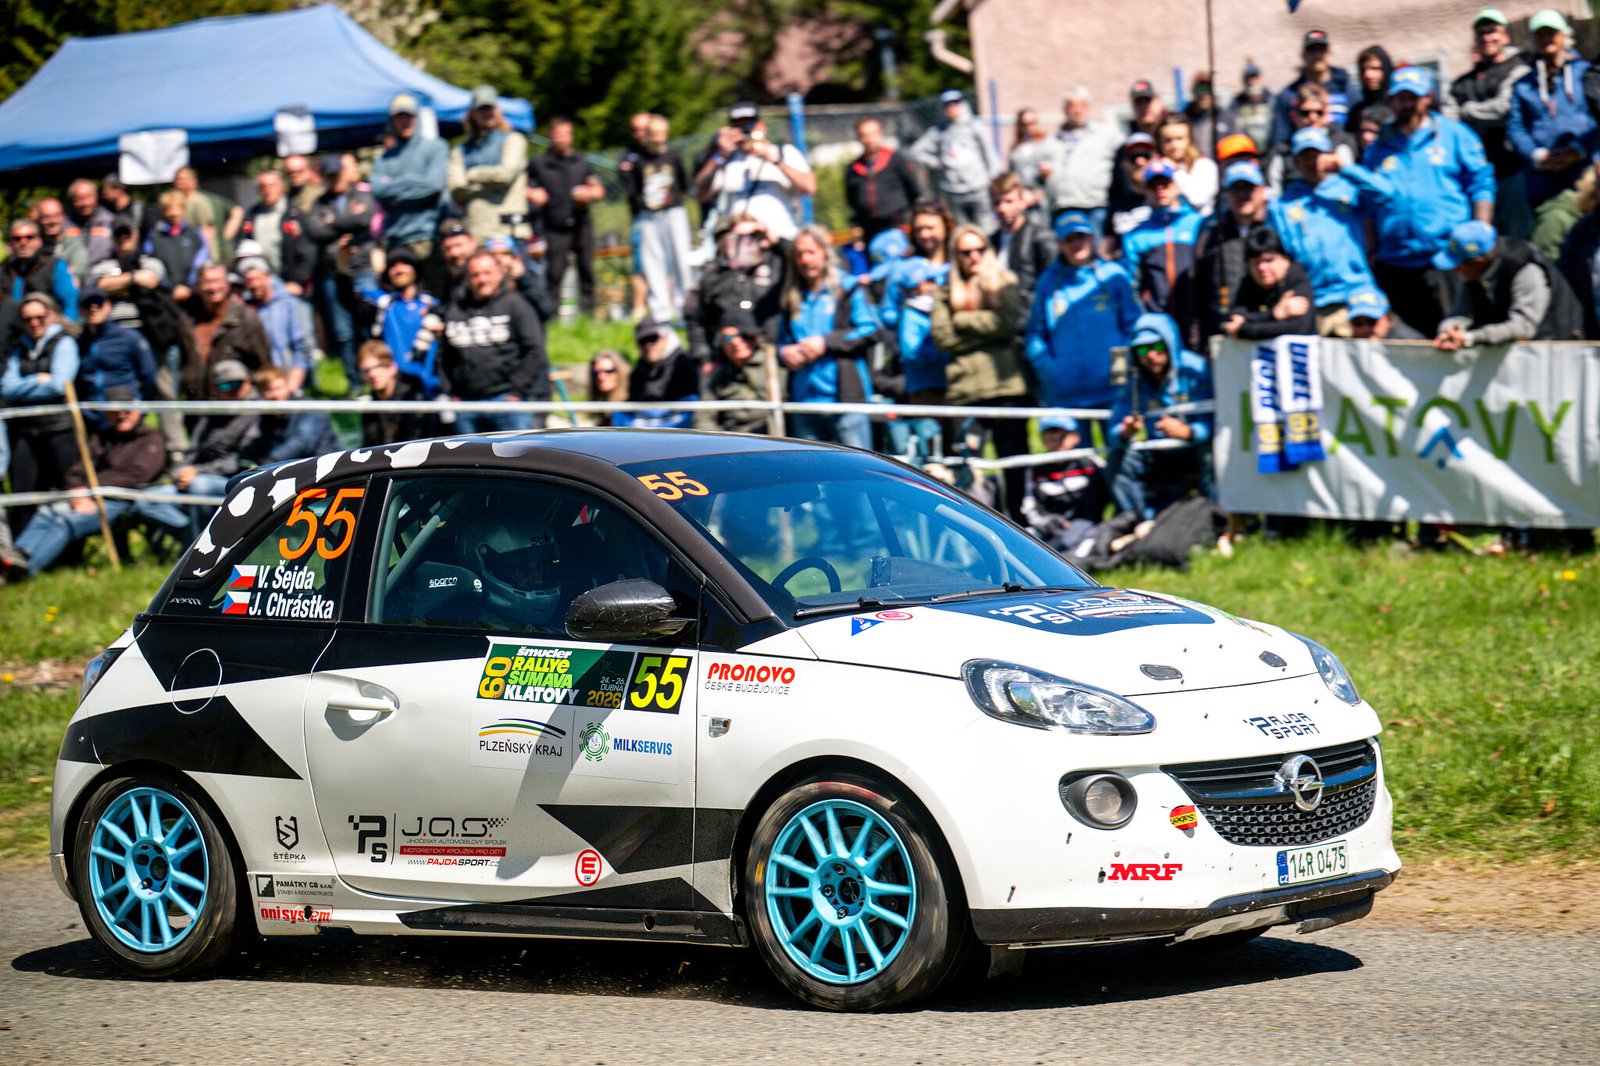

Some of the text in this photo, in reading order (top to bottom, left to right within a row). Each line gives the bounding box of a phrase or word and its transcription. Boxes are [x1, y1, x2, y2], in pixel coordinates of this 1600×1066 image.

[636, 471, 710, 501] 55
[279, 487, 366, 560] 55
[258, 560, 315, 594] V. Šejda
[248, 592, 335, 619] J. Chrástka
[707, 662, 796, 684] PRONOVO
[600, 684, 625, 692] DUBNA
[630, 656, 688, 709] 55
[704, 680, 790, 695] ČESKÉ BUDĚJOVICE
[503, 684, 580, 705] KLATOVY
[586, 690, 622, 708] 2026
[479, 738, 563, 757] PLZEŇSKÝ KRAJ
[613, 738, 673, 756] MILKSERVIS
[273, 852, 306, 860] ŠTĚPKA
[1107, 863, 1183, 881] MRF
[1279, 874, 1289, 884] CZ
[276, 880, 308, 888] PAMÁTKY
